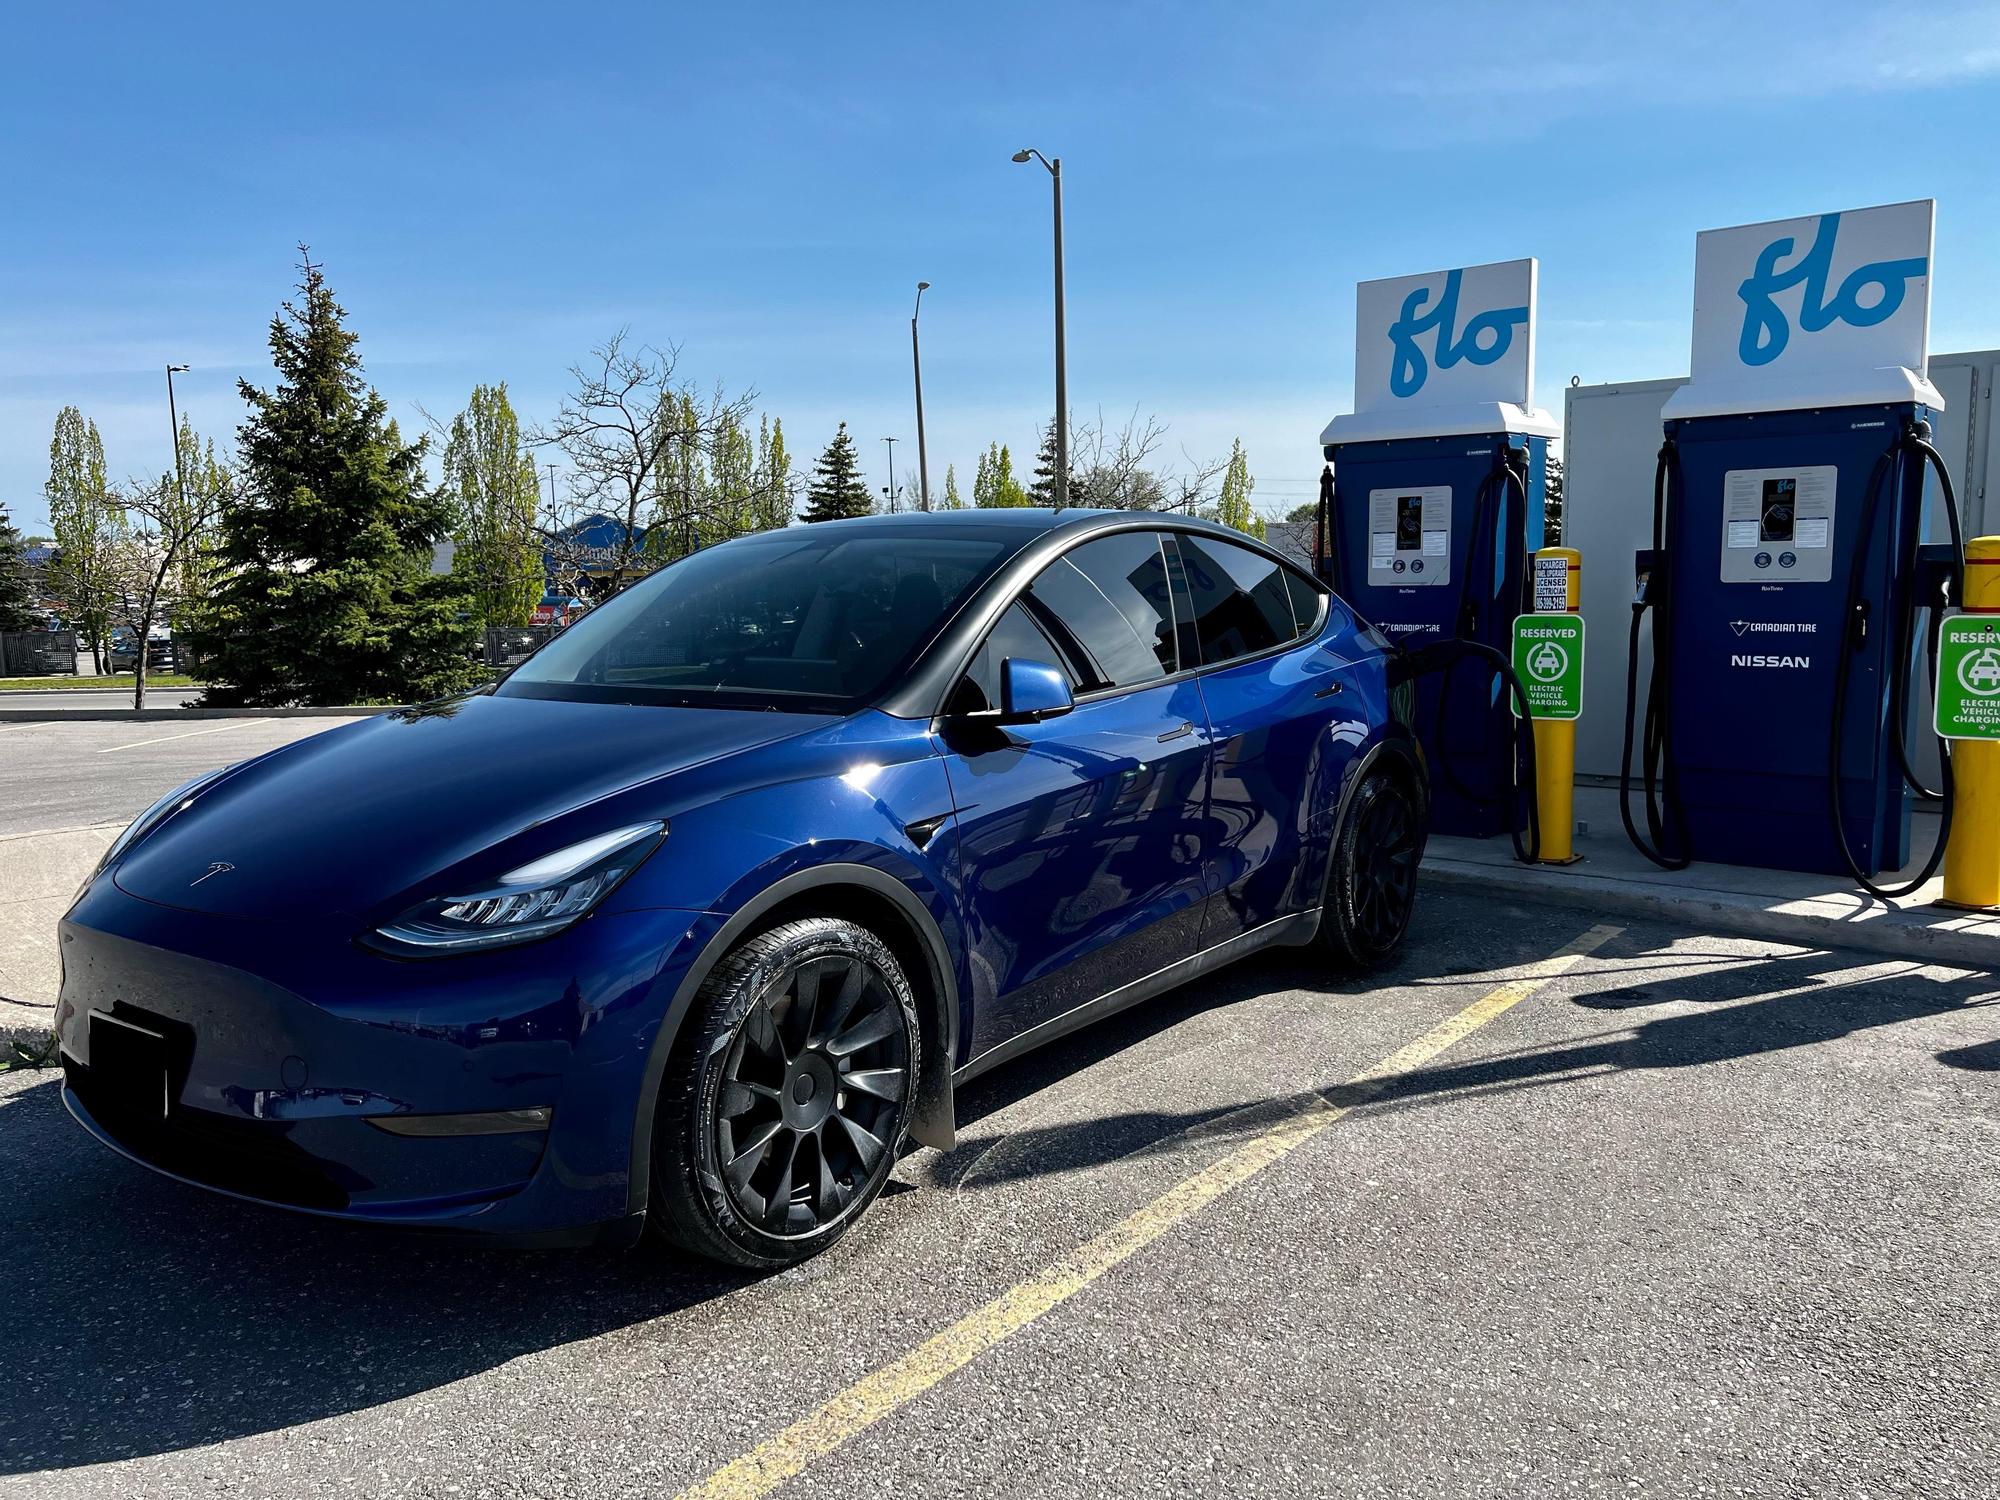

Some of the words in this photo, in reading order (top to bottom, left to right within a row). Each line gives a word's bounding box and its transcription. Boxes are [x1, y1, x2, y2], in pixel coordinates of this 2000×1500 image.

[1738, 213, 1928, 366] flo
[1388, 269, 1529, 398] flo
[1536, 578, 1567, 587] LICENSED
[1520, 628, 1577, 638] RESERVED
[1750, 623, 1796, 632] CANADIAN
[1796, 623, 1817, 633] TIRE
[1731, 655, 1810, 668] NISSAN
